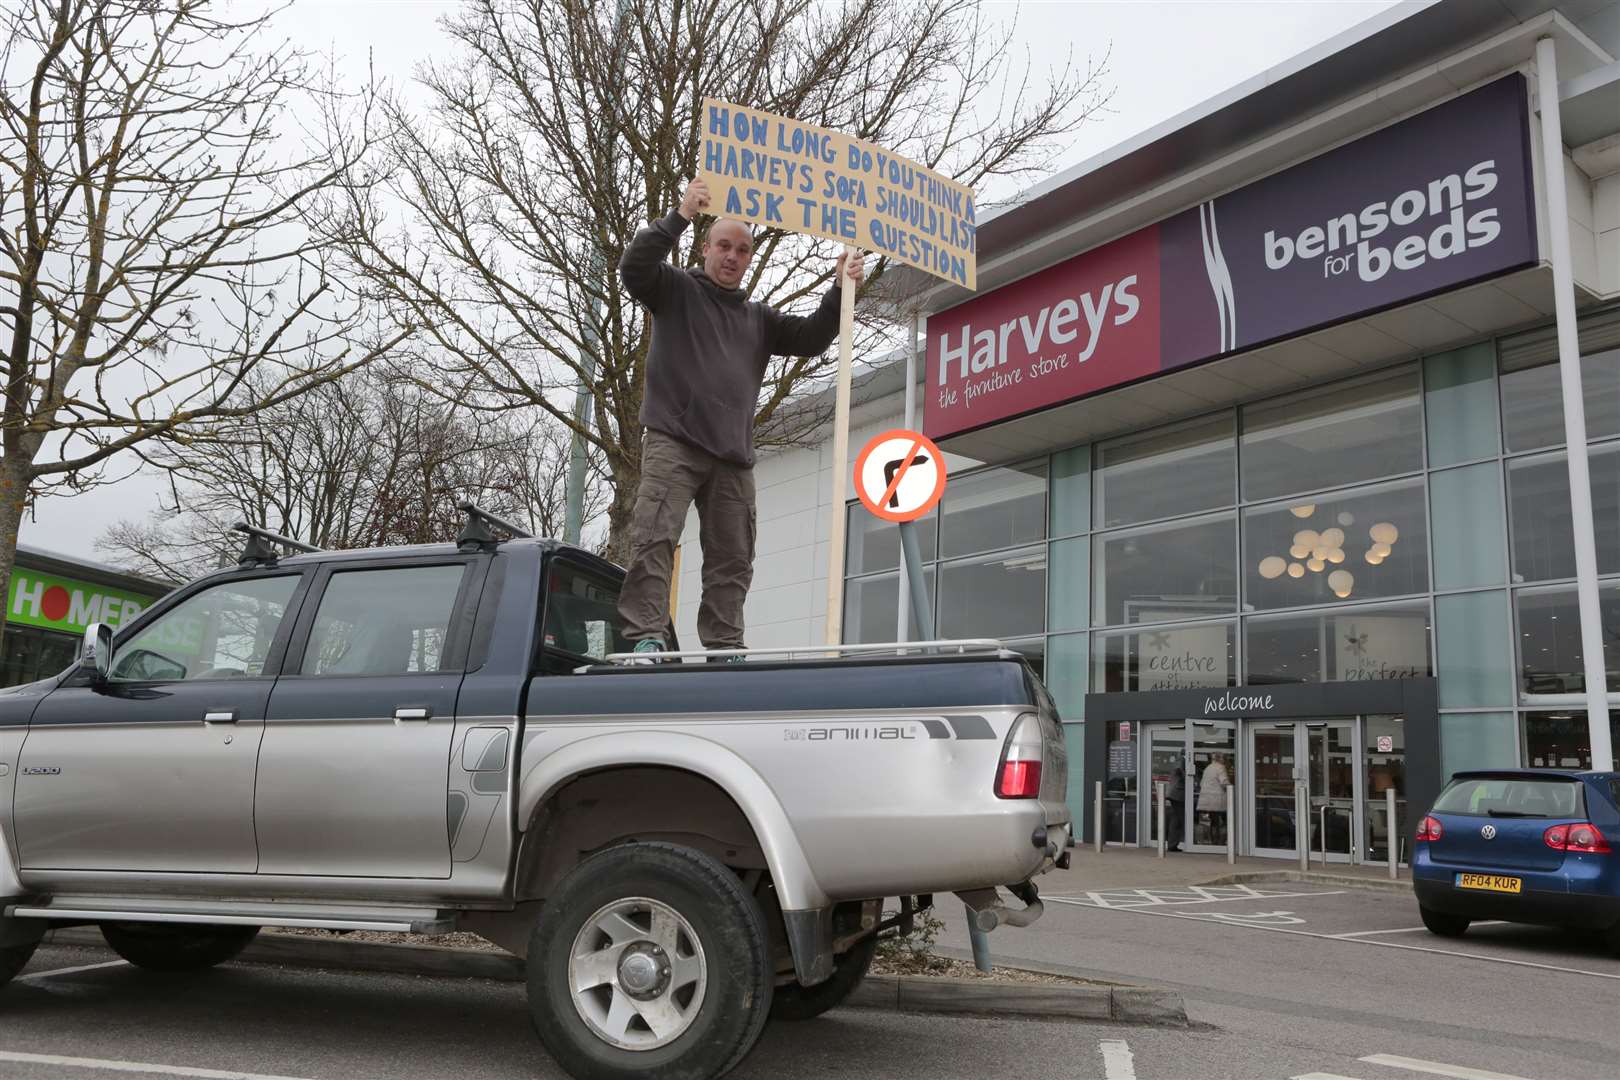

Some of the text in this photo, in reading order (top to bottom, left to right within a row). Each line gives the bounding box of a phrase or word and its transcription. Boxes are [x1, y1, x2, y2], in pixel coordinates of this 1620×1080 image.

[705, 140, 977, 254] HARVEYS SOFA SHOULD LAST
[709, 106, 976, 224] HOW LONG DO YOU THINK A
[725, 186, 967, 286] ASK THE QUESTION
[1264, 159, 1499, 270] bensons
[1324, 206, 1501, 282] for beds
[938, 274, 1140, 386] Harveys
[938, 352, 1069, 409] the furniture store
[1149, 651, 1217, 672] centre
[1204, 691, 1274, 714] welcome
[1463, 874, 1518, 889] RF04 KUR
